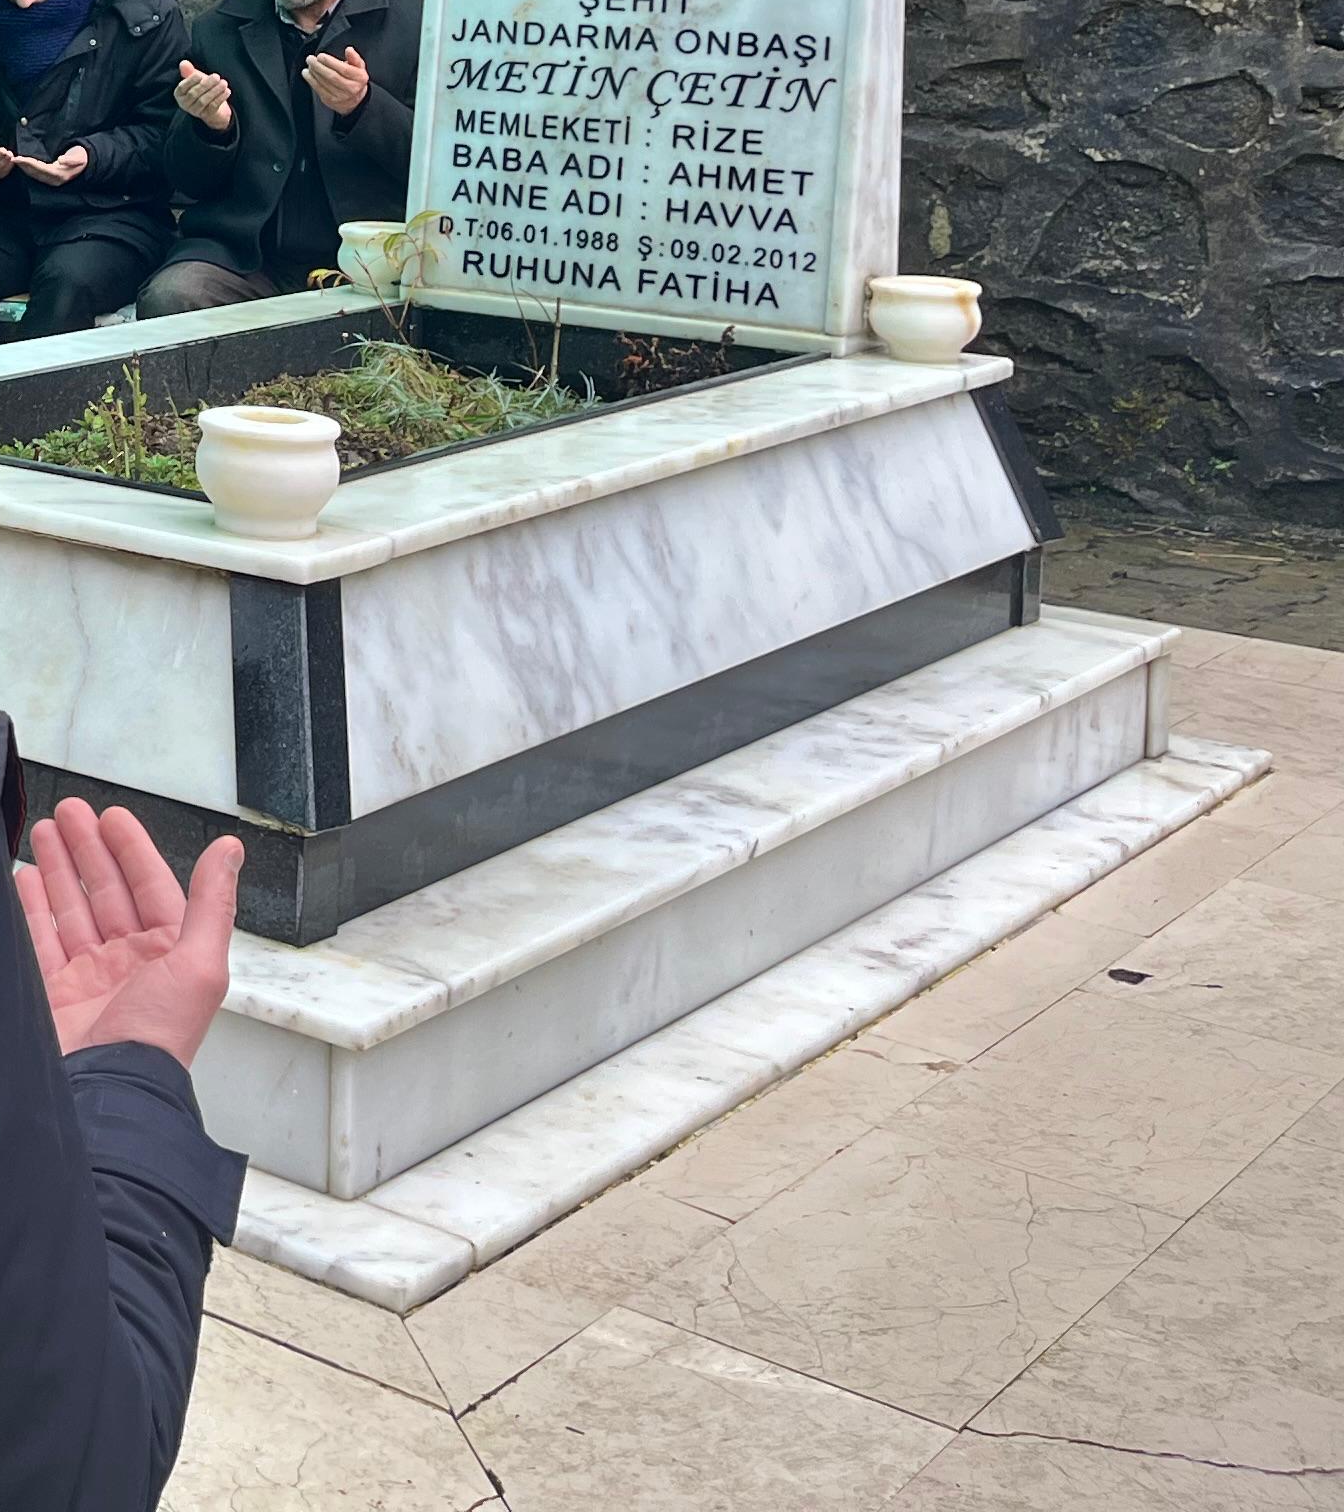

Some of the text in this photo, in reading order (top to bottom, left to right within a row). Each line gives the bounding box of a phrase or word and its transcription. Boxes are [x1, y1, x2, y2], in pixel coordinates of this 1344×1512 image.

[451, 18, 831, 68] JANDARMA ONBAŞI
[446, 56, 837, 118] METİN ÇETİN
[455, 108, 631, 146] MEMLEKETİ
[672, 119, 764, 156] RİZE
[452, 143, 549, 176] BABA
[559, 152, 624, 181] ADI
[668, 161, 814, 197] AHMET
[451, 179, 549, 211] ANNE
[561, 188, 622, 218] ADI
[665, 197, 798, 235] HAVVA
[462, 249, 780, 310] RUHUNA FATİHA
